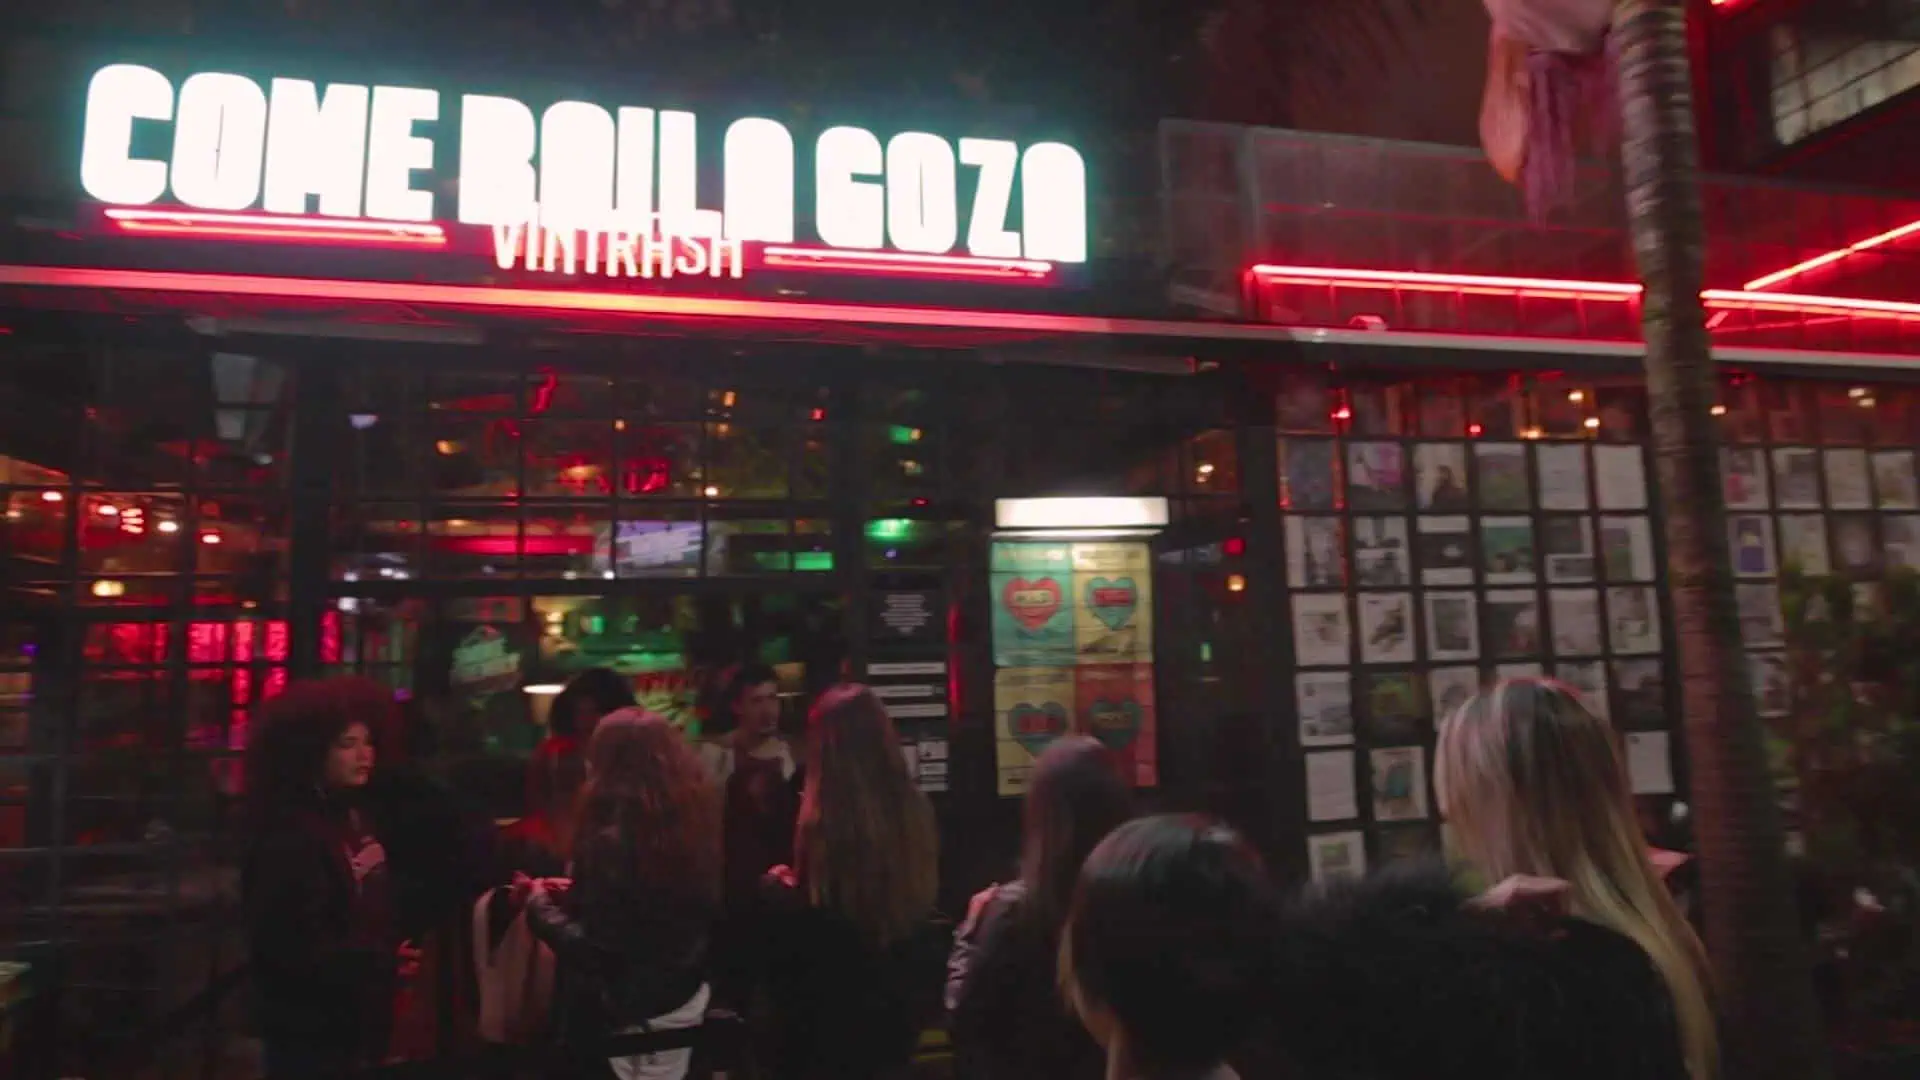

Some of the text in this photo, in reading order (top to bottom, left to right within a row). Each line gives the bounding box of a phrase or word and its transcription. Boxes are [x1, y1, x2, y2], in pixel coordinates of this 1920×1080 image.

[80, 64, 1087, 263] COME BAILA GOZA
[491, 207, 744, 279] VINTRASH
